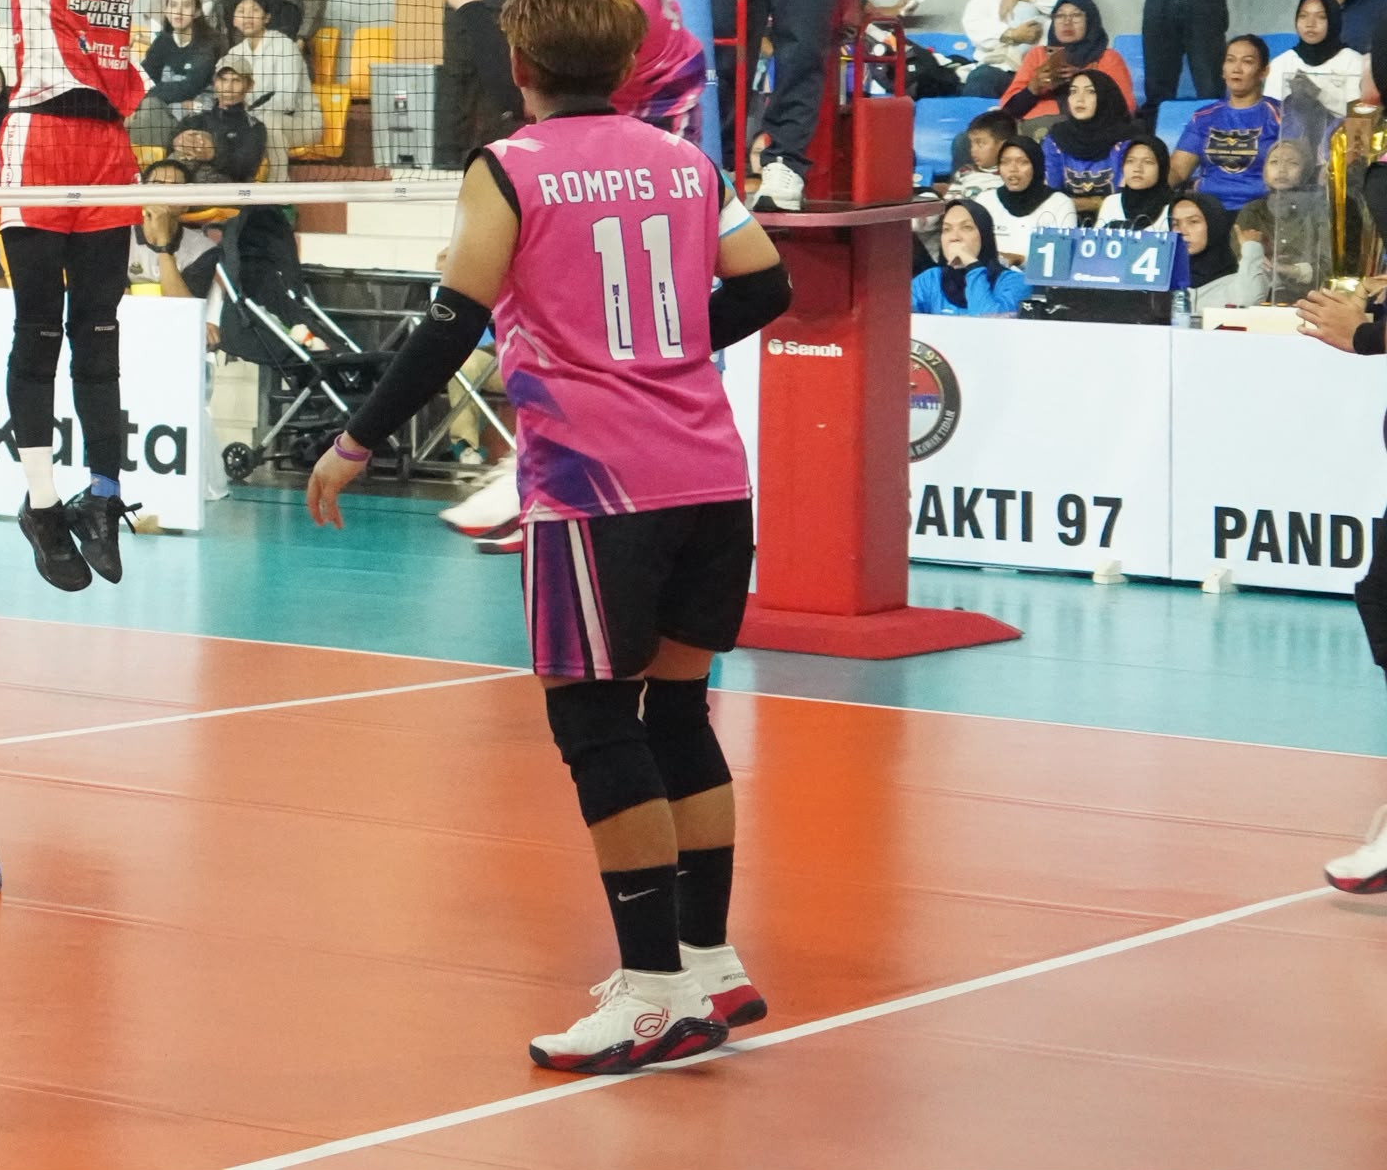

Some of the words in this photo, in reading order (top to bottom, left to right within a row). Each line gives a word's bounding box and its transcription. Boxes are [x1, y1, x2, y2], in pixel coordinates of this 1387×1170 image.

[537, 168, 655, 206] ROMPIS
[669, 166, 704, 199] JR
[592, 214, 685, 361] 11
[1037, 241, 1056, 278] 1
[1080, 239, 1097, 258] 0
[1105, 240, 1122, 259] 0
[1131, 247, 1161, 283] 4
[784, 340, 844, 358] Senoh
[909, 483, 1034, 543] AKTI
[1056, 493, 1123, 549] 97
[1214, 505, 1382, 570] PAND
